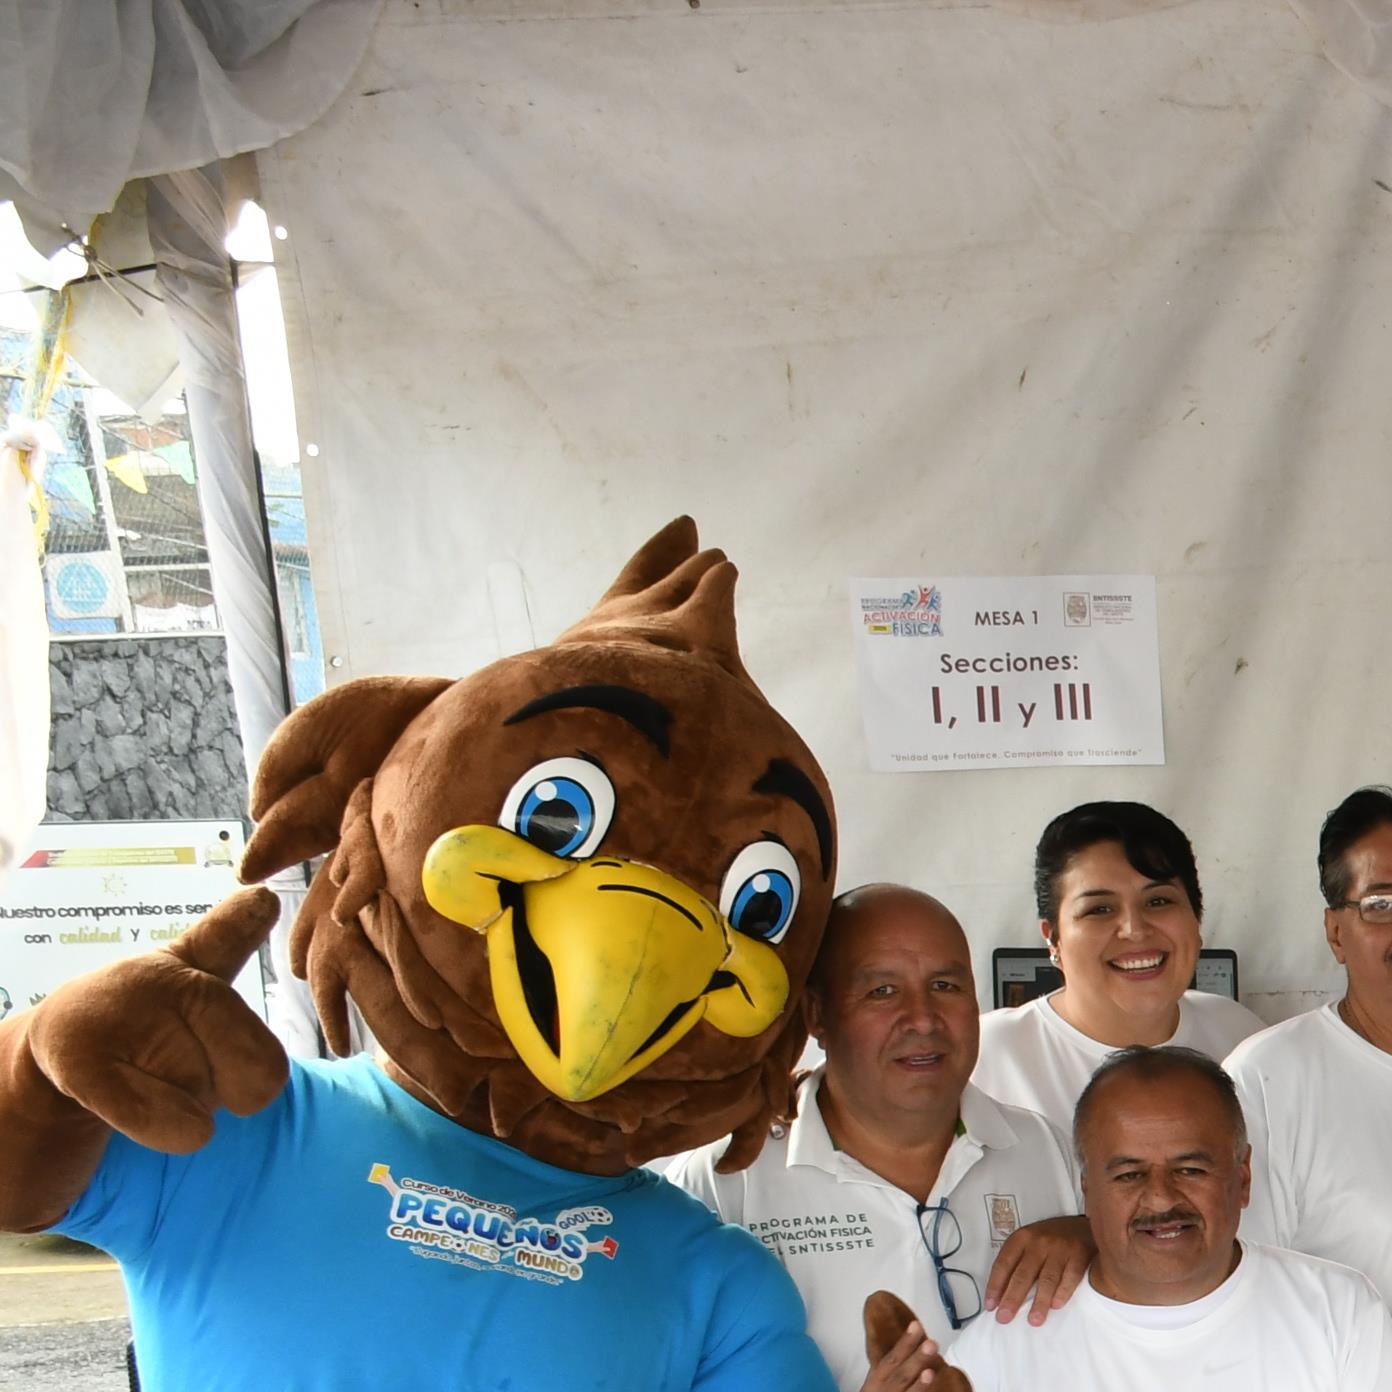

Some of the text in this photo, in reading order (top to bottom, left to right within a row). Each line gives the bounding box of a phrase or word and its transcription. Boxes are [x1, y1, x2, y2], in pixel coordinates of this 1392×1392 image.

[974, 610, 1038, 627] MESA 1
[941, 653, 1079, 674] Secciones:
[932, 683, 1093, 729] I, II y III
[58, 902, 162, 921] compromiso
[165, 903, 183, 914] es
[24, 933, 51, 944] con
[131, 928, 139, 942] y
[402, 1179, 437, 1194] Curso
[750, 1213, 868, 1232] PROGRAMA DE
[755, 1226, 872, 1244] CTIVACIÓN FISICA
[789, 1238, 874, 1254] SNTISSSTE
